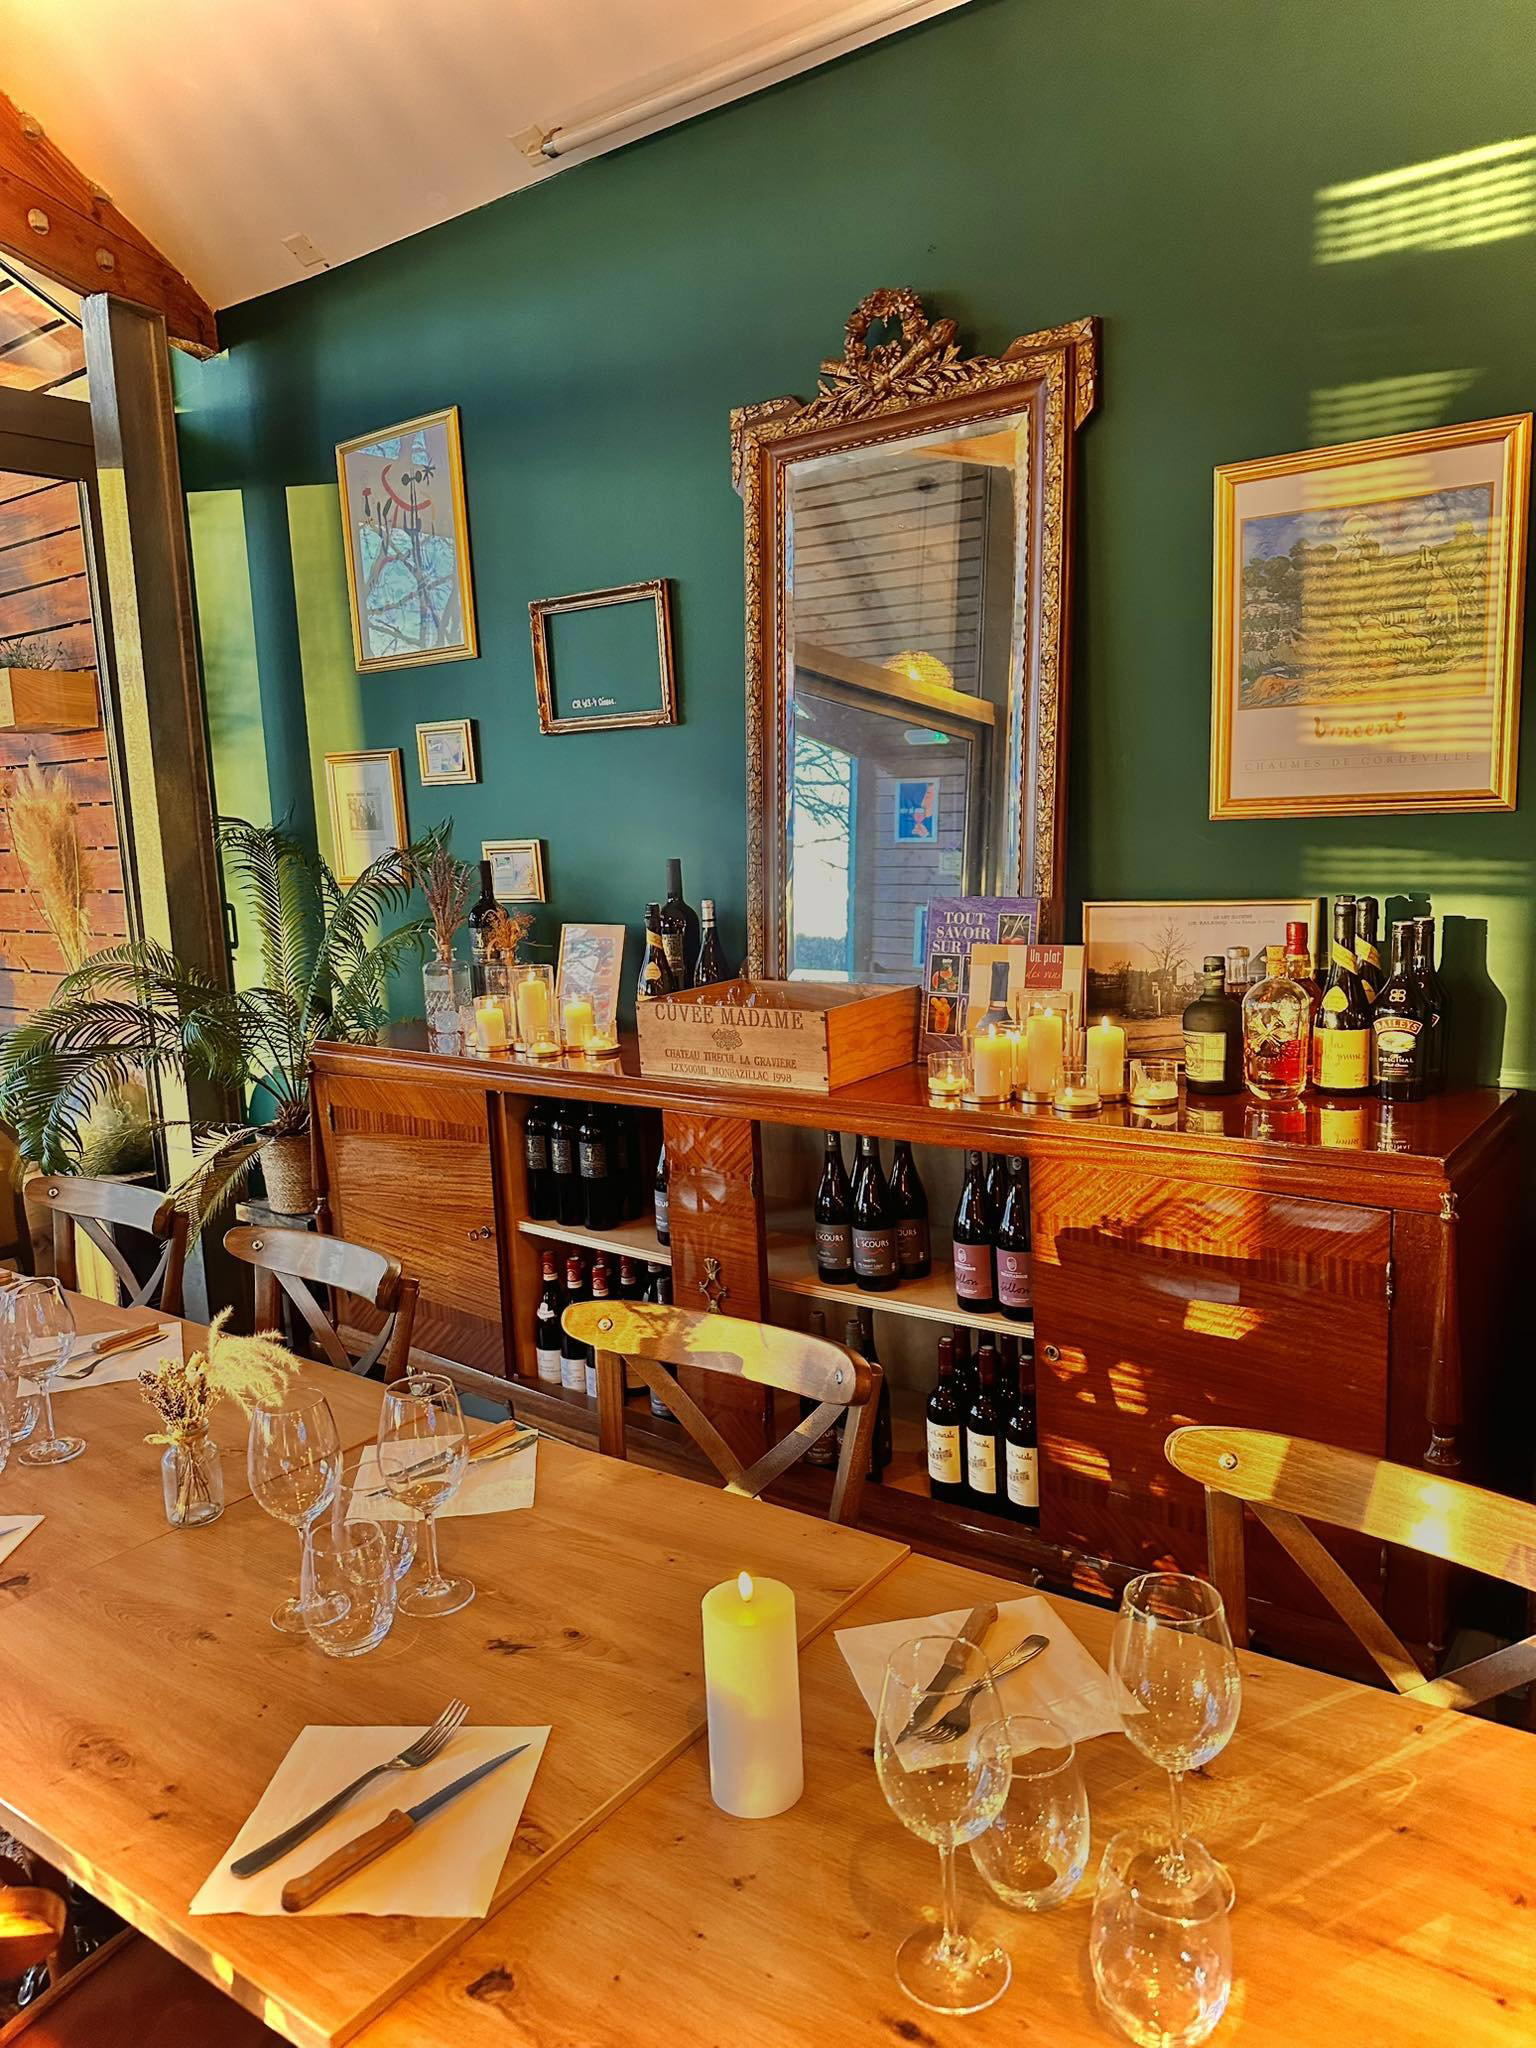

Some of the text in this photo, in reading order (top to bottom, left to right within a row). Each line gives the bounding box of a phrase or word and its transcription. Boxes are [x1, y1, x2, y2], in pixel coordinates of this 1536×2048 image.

[1314, 711, 1406, 738] Vincent
[1245, 759, 1322, 771] CHAUMES
[1331, 757, 1349, 767] DE
[944, 912, 986, 925] TOUT
[936, 926, 991, 940] SAVOIR
[932, 940, 961, 953] SUR
[1030, 949, 1041, 962] Un
[720, 1006, 804, 1030] MADAME
[1375, 1018, 1420, 1032] BAILEYS
[739, 1055, 751, 1065] LA
[773, 1071, 792, 1083] 1998
